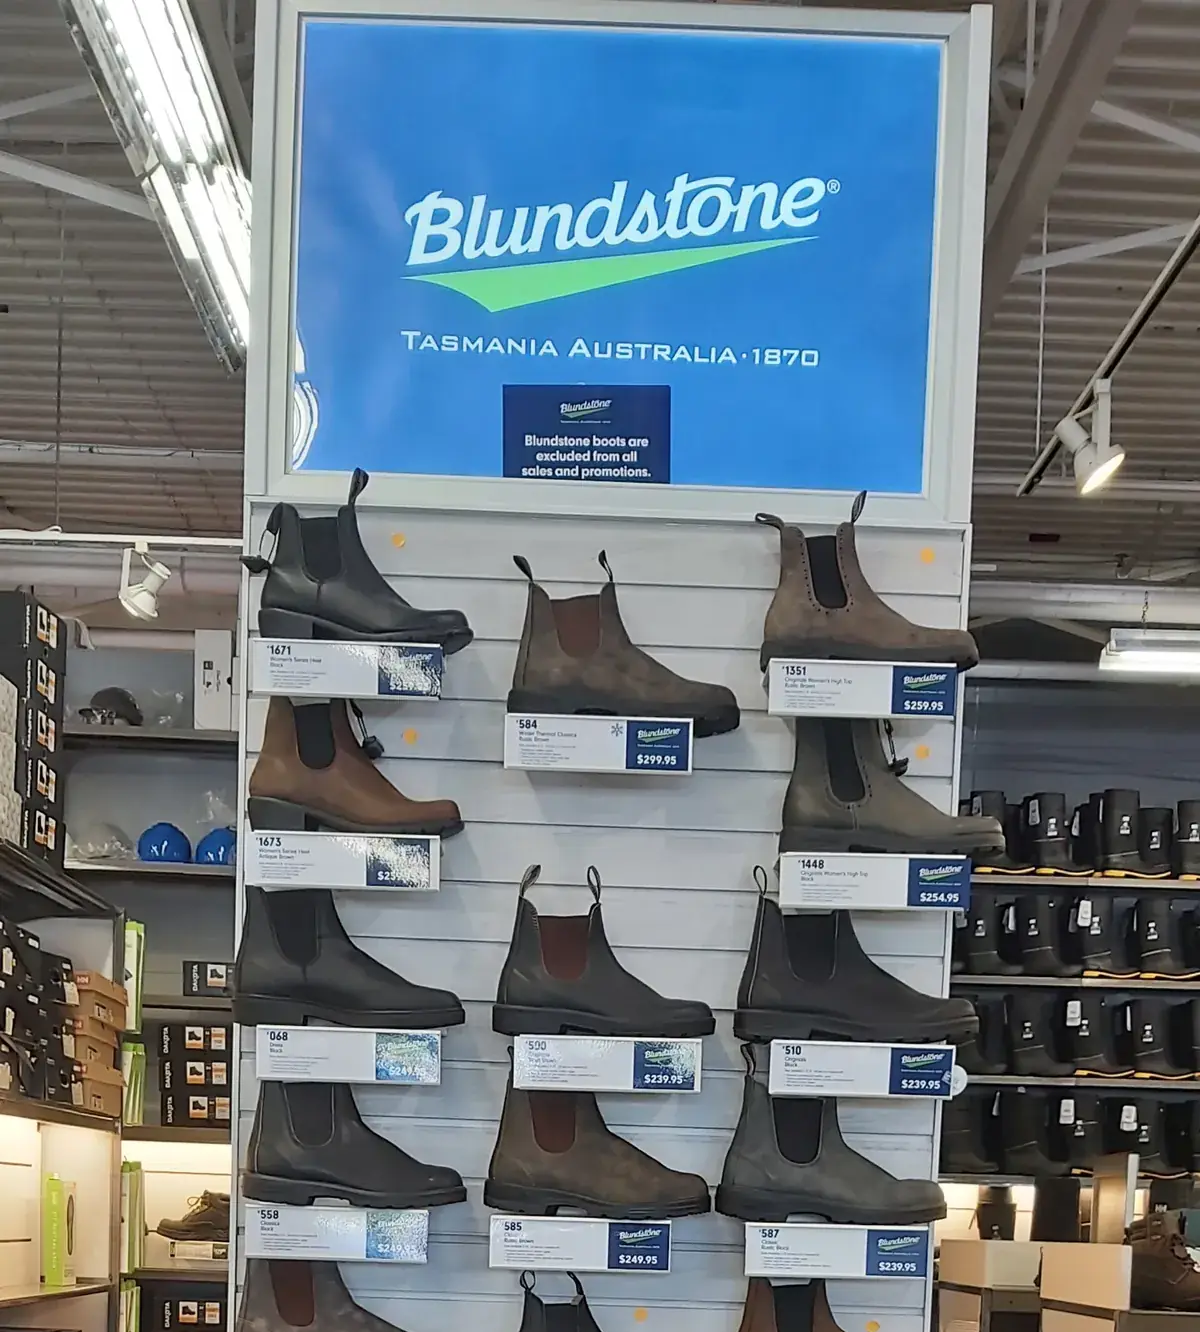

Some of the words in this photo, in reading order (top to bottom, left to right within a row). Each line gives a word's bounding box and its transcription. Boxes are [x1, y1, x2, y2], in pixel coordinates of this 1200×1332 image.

[401, 330, 558, 357] TASMANIA
[525, 435, 590, 446] Blundstone
[593, 435, 626, 447] boots
[628, 437, 648, 447] are
[536, 450, 590, 462] excluded
[593, 451, 619, 462] from
[622, 451, 637, 462] all
[522, 465, 552, 477] sales
[555, 466, 579, 477] and
[581, 466, 651, 479] promotions.
[904, 700, 943, 711] $259.95
[637, 755, 677, 765] $299.95
[920, 893, 959, 902] $254.95
[644, 1075, 683, 1084] $239.95
[901, 1080, 940, 1089] $239.95
[619, 1255, 657, 1264] $249.95
[879, 1262, 916, 1271] $239.95
